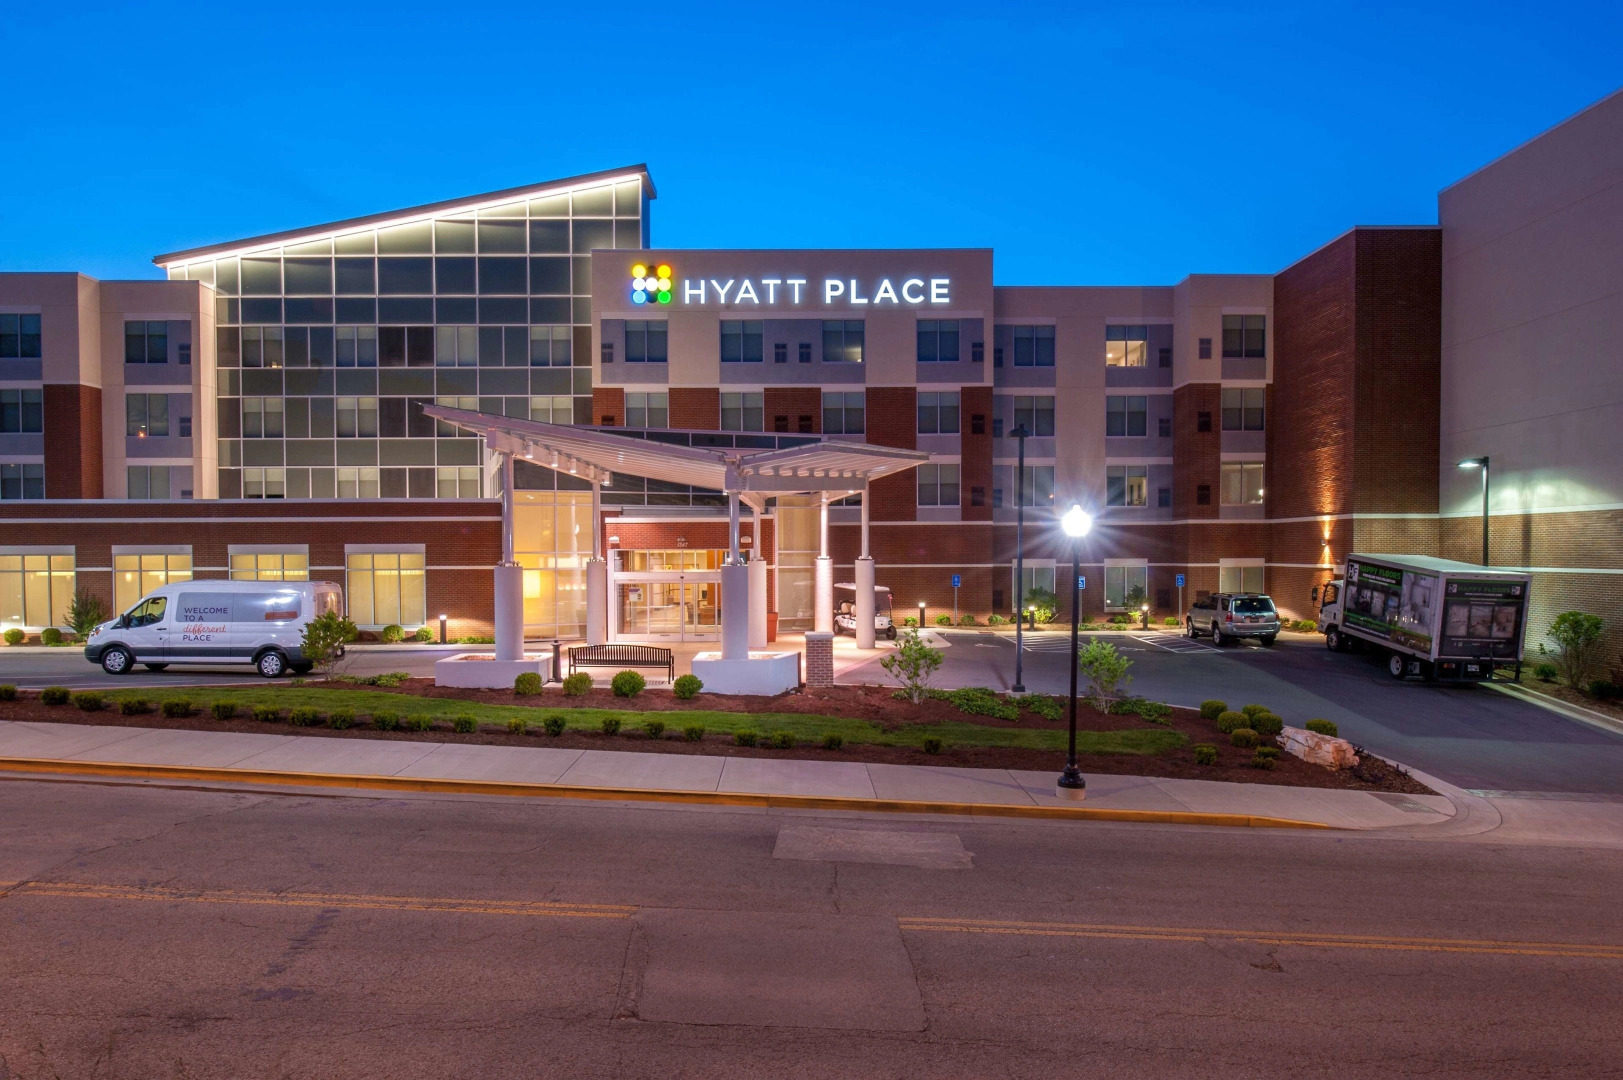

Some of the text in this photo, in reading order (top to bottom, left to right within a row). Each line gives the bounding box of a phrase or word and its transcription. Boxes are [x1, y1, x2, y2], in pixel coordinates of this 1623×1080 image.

[684, 278, 950, 304] HYATT PLACE
[1360, 563, 1378, 575] HAPPY
[1379, 569, 1401, 580] FLOORS
[183, 623, 227, 635] different
[182, 634, 212, 642] PLACE
